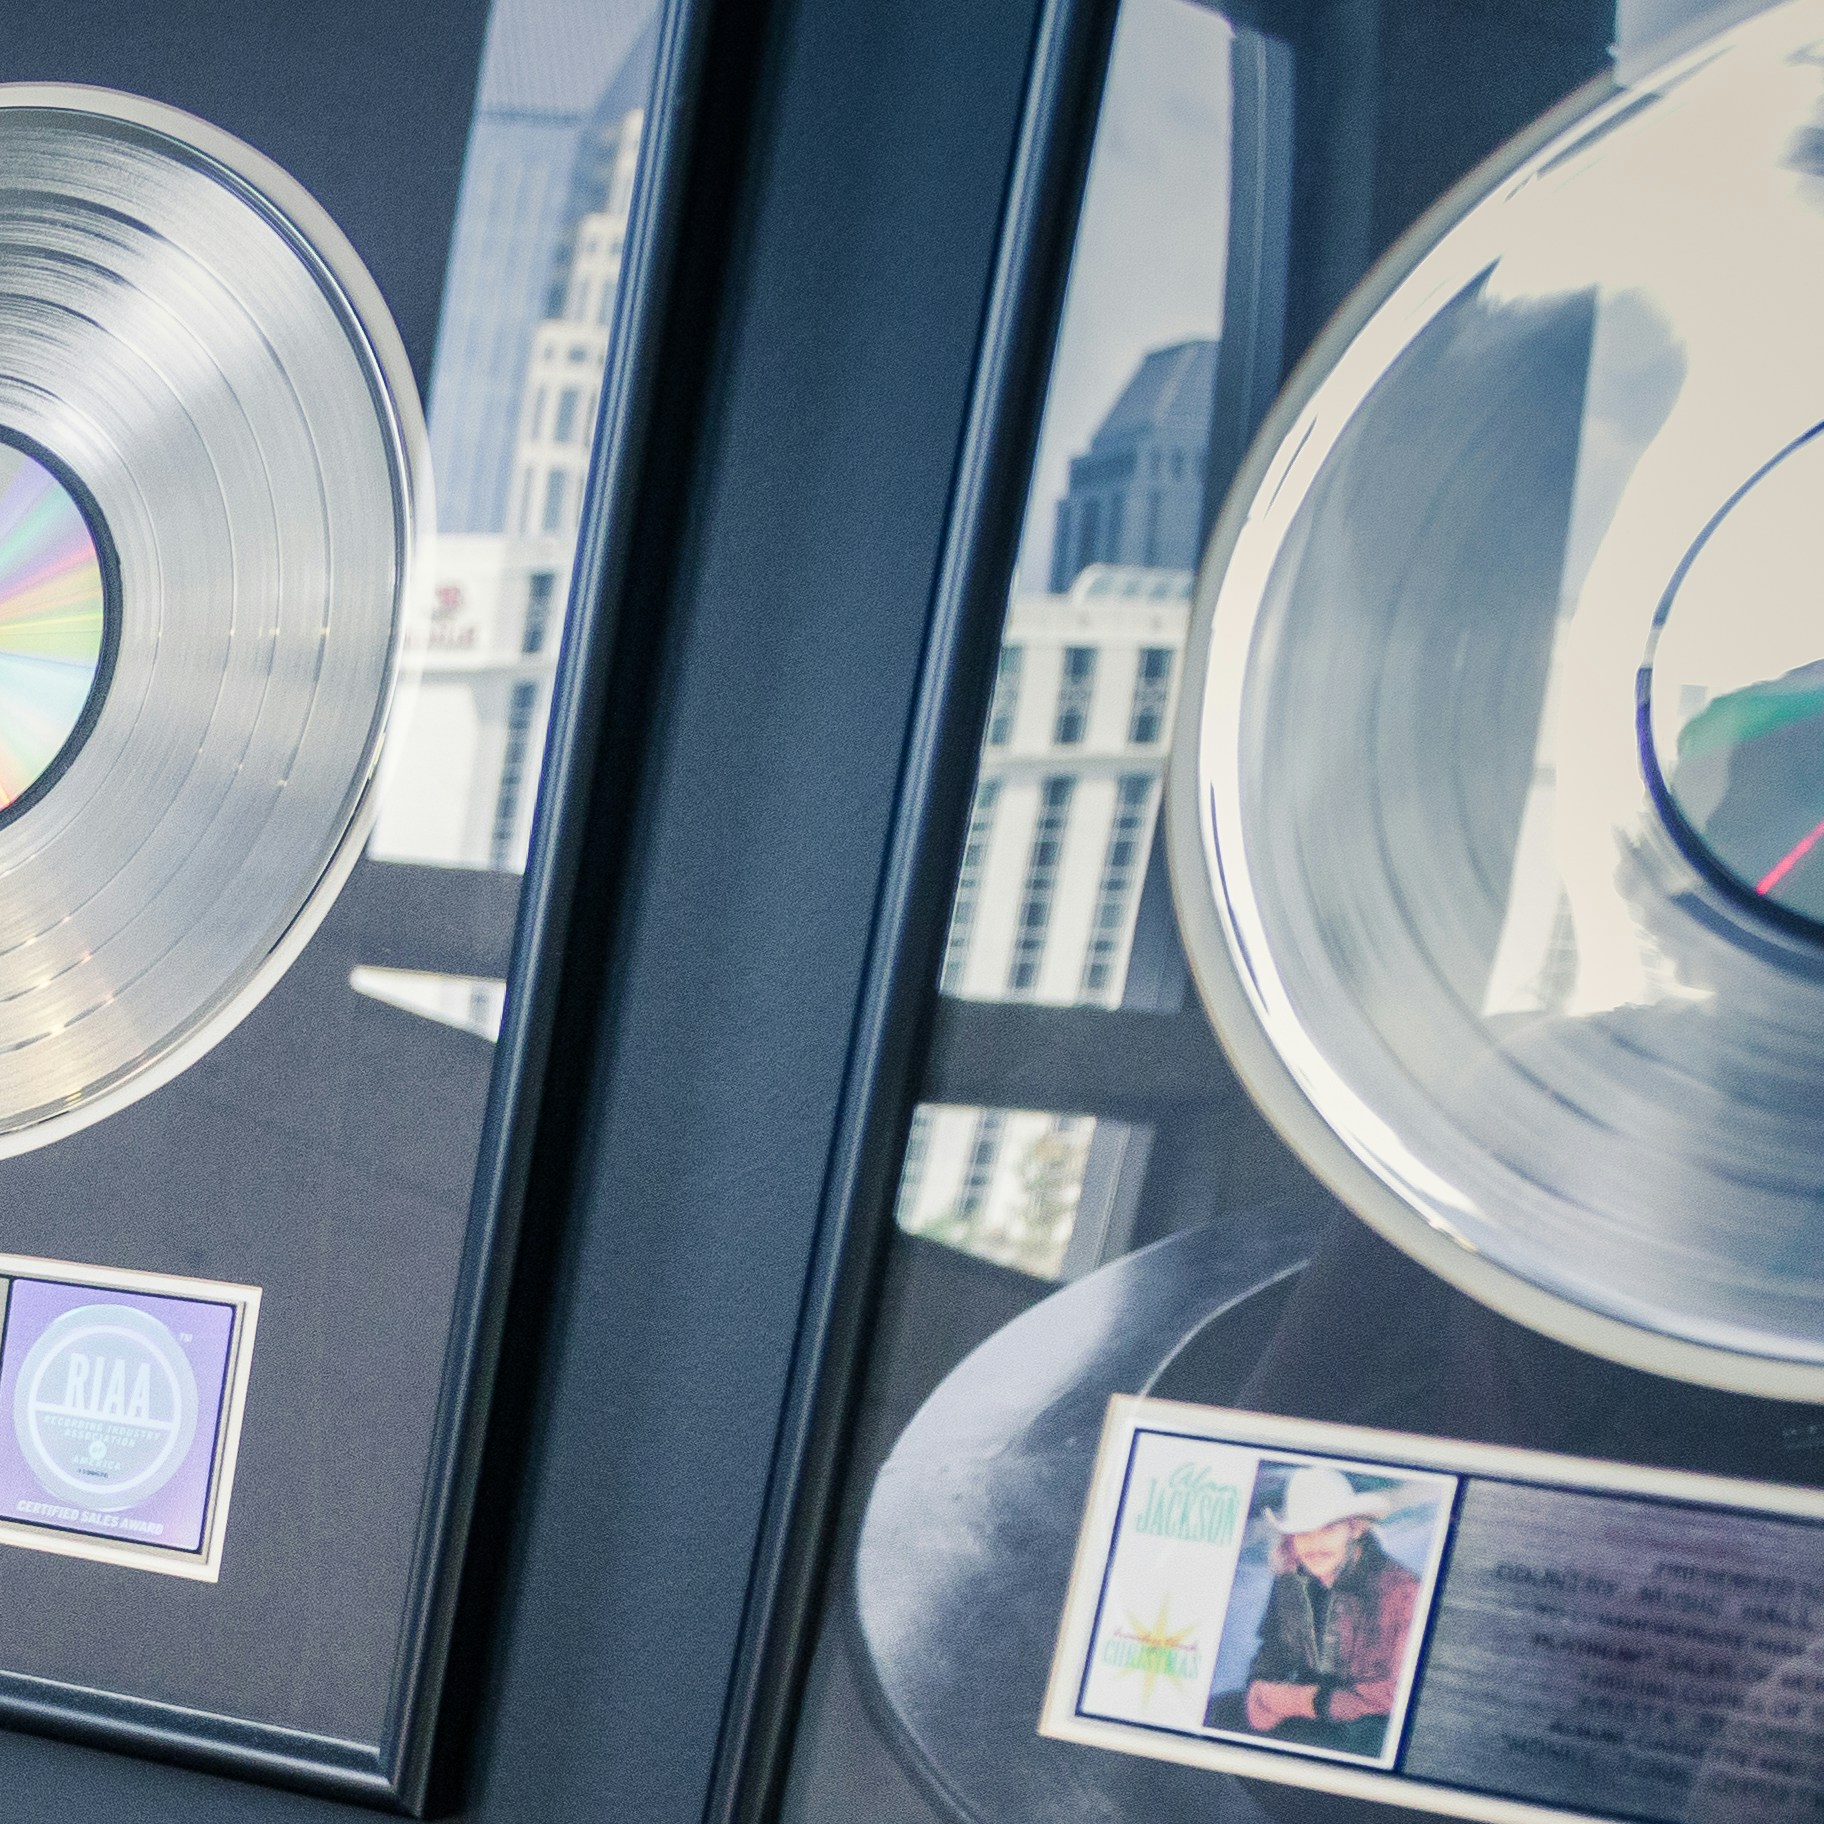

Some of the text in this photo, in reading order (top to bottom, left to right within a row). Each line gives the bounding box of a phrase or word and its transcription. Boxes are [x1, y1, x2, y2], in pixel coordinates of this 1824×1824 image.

[63, 1351, 157, 1419] RIAA
[16, 1498, 164, 1536] CERTIFIED SALES AWARD
[1135, 1477, 1241, 1546] JACKSON
